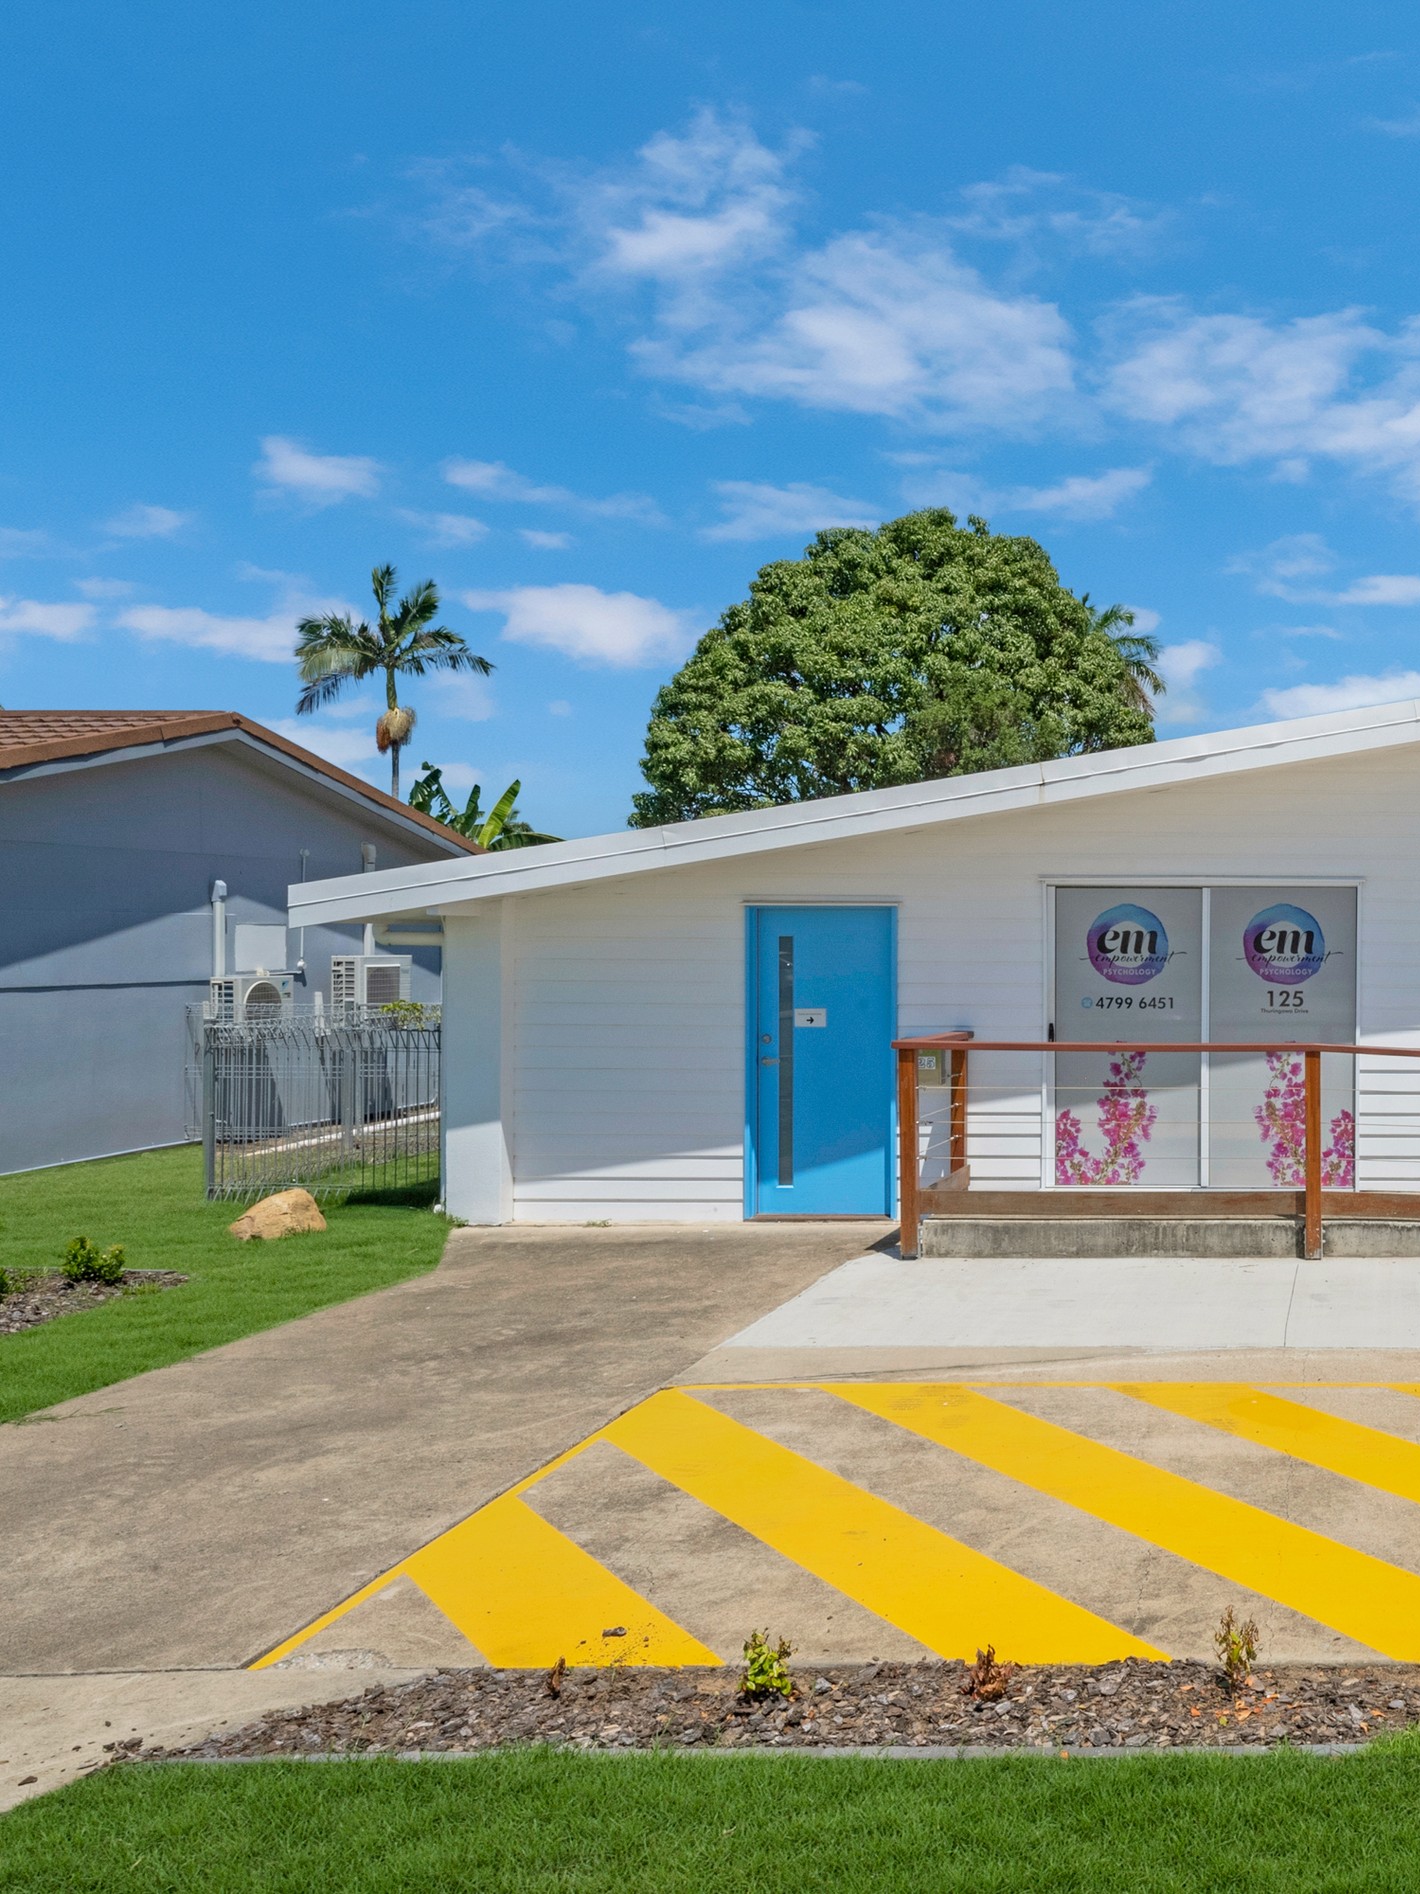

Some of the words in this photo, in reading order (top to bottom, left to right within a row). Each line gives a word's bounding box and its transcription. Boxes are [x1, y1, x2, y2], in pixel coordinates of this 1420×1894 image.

[1097, 930, 1158, 954] em
[1253, 930, 1315, 954] em
[1079, 951, 1188, 968] empowerment
[1236, 951, 1344, 968] empowerment
[1103, 968, 1157, 976] PSYCHOLOGY
[1260, 968, 1313, 976] PSYCHOLOGY
[1095, 997, 1134, 1009] 4799
[1138, 997, 1174, 1009] 6451
[1267, 990, 1304, 1007] 125
